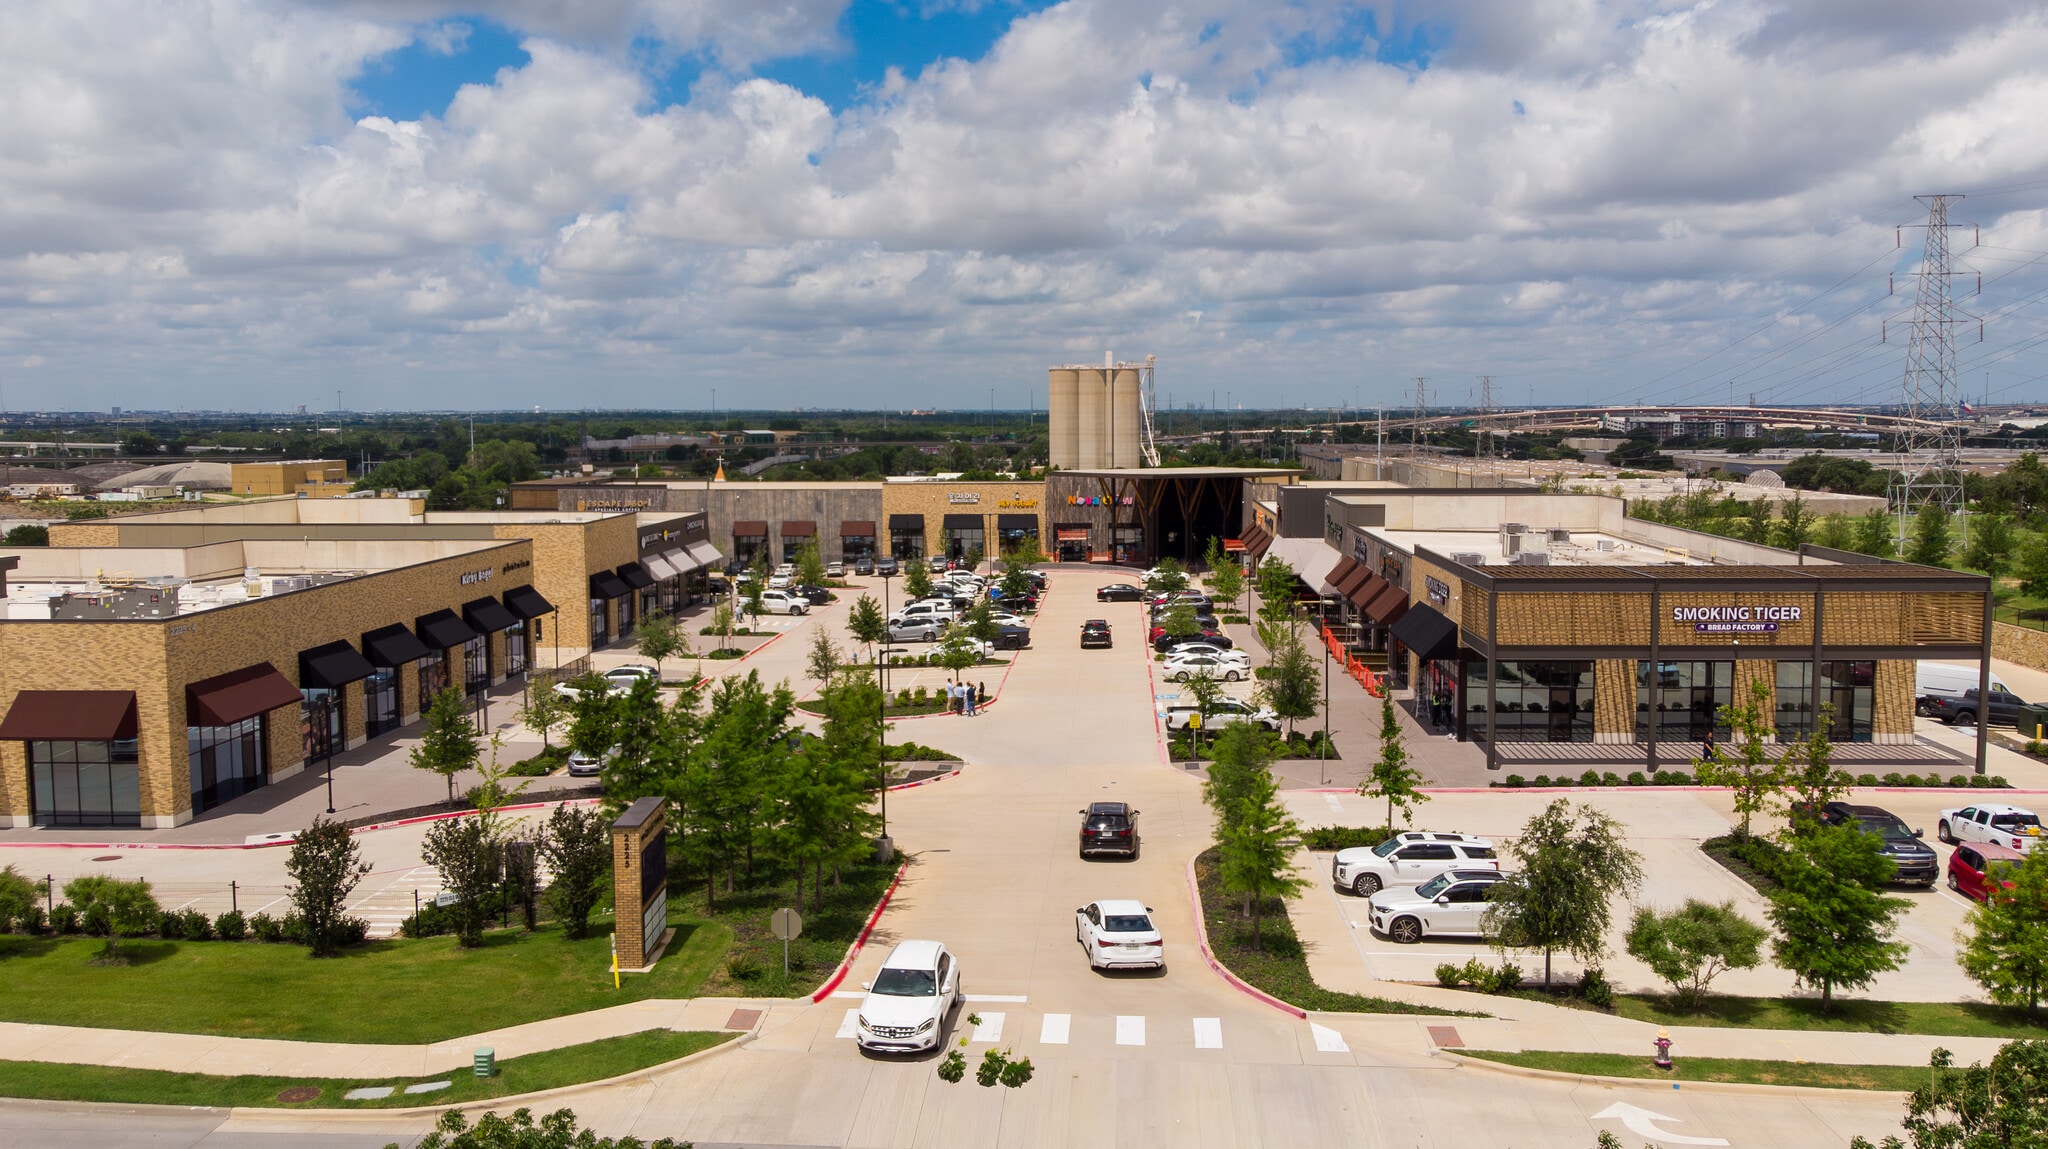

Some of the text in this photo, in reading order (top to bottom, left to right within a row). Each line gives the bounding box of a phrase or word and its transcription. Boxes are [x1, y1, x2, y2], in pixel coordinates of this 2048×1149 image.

[1068, 495, 1100, 505] Nova
[461, 566, 494, 586] Kirby Bagel
[1673, 606, 1802, 621] SMOKING TIGER
